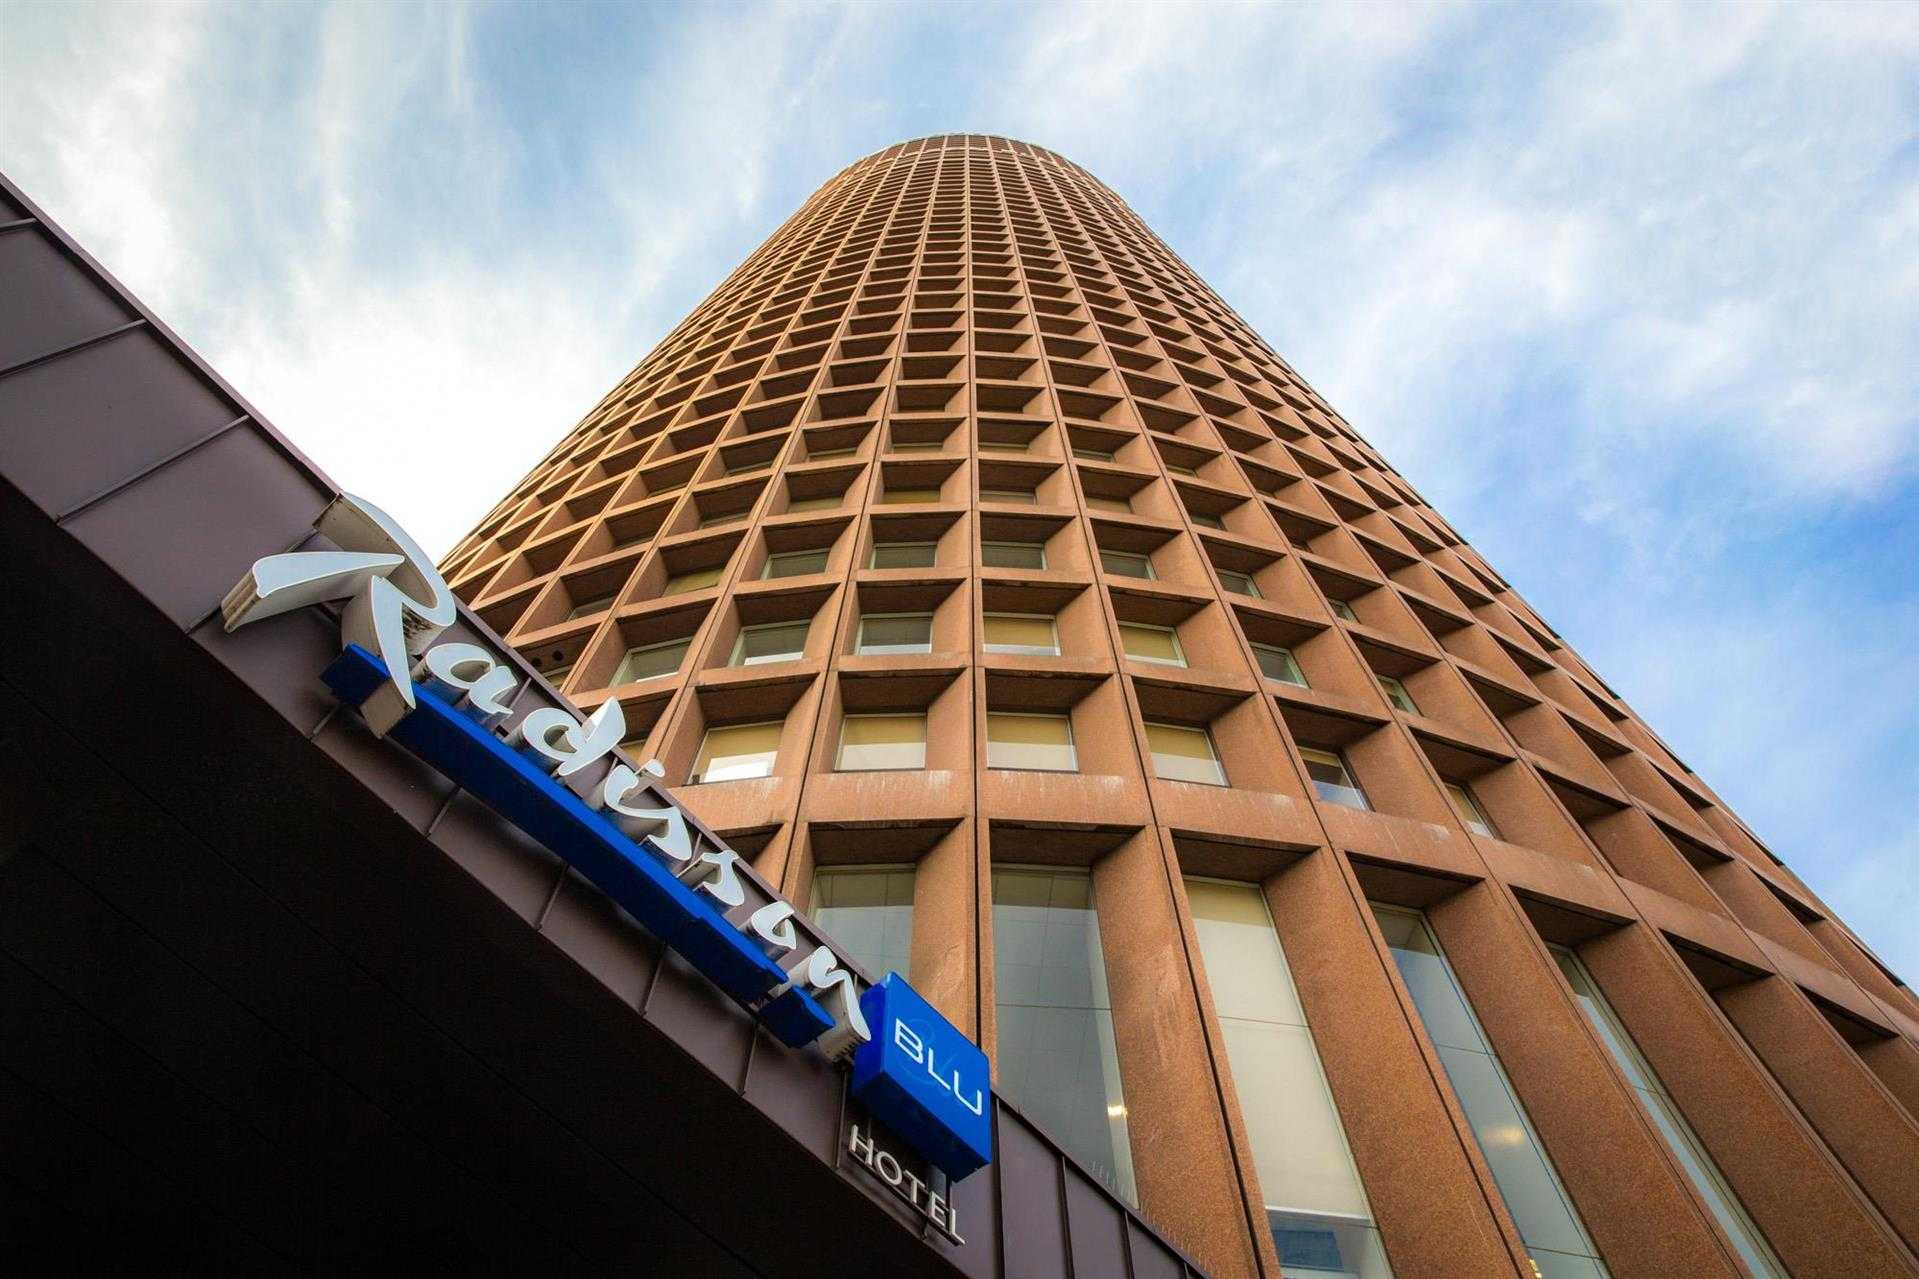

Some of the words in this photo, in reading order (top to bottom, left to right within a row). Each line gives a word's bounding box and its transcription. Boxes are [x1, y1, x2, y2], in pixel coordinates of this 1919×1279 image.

[245, 491, 872, 1043] Radisson
[894, 1018, 983, 1116] BLU
[850, 1124, 966, 1246] HOTEL
